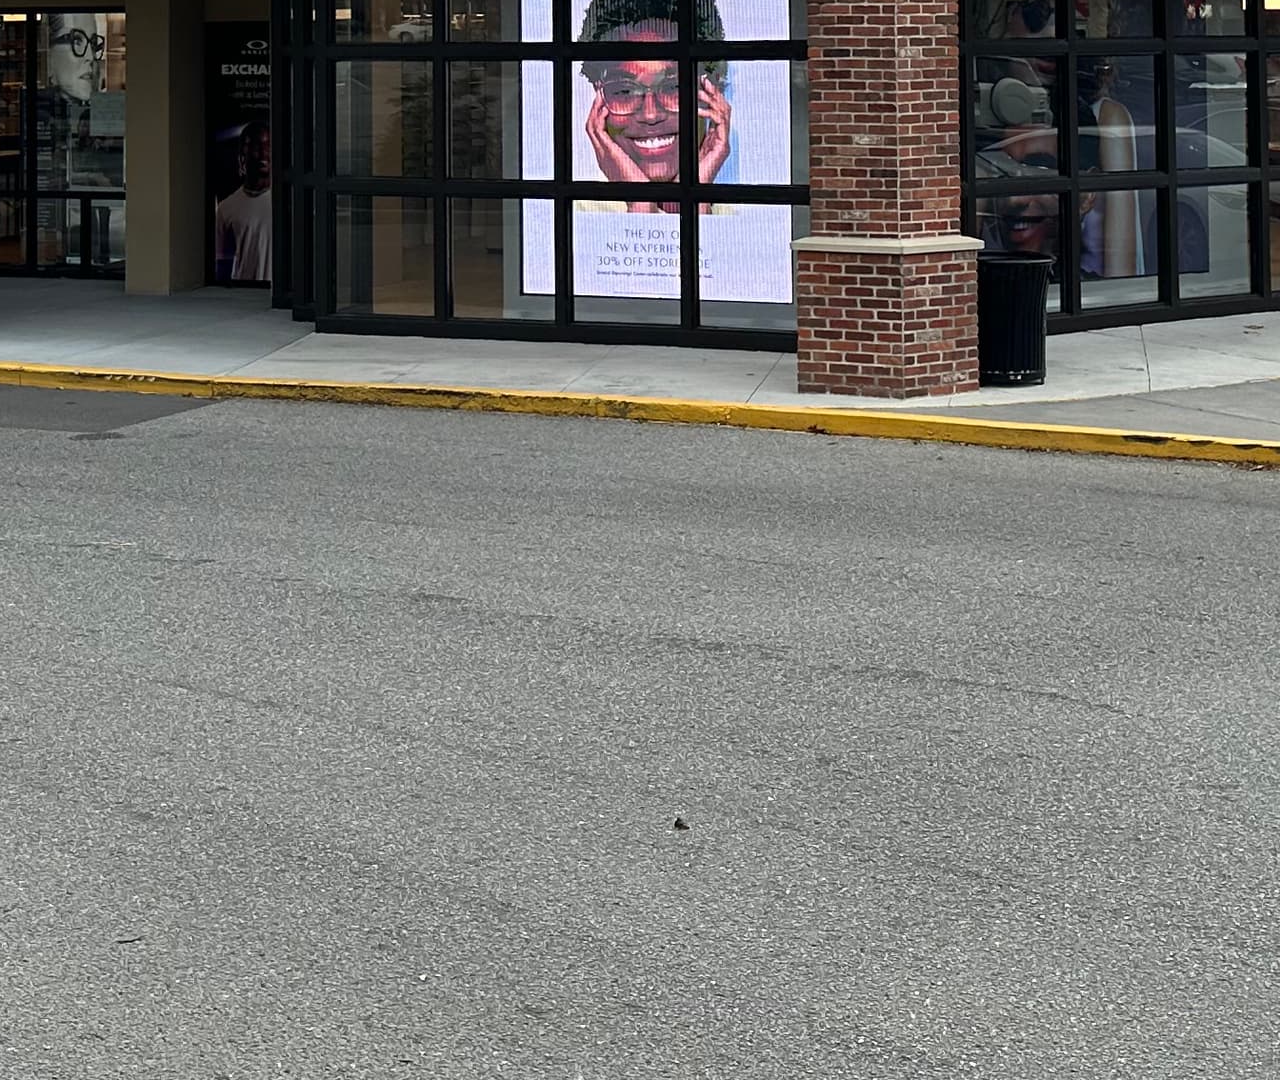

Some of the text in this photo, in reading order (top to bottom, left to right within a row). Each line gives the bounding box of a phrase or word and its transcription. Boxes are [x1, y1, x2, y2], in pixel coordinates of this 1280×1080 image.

[624, 228, 644, 239] THE
[648, 229, 665, 240] JOY
[606, 242, 629, 253] NEW
[597, 255, 620, 266] 30%
[624, 256, 643, 267] OFF
